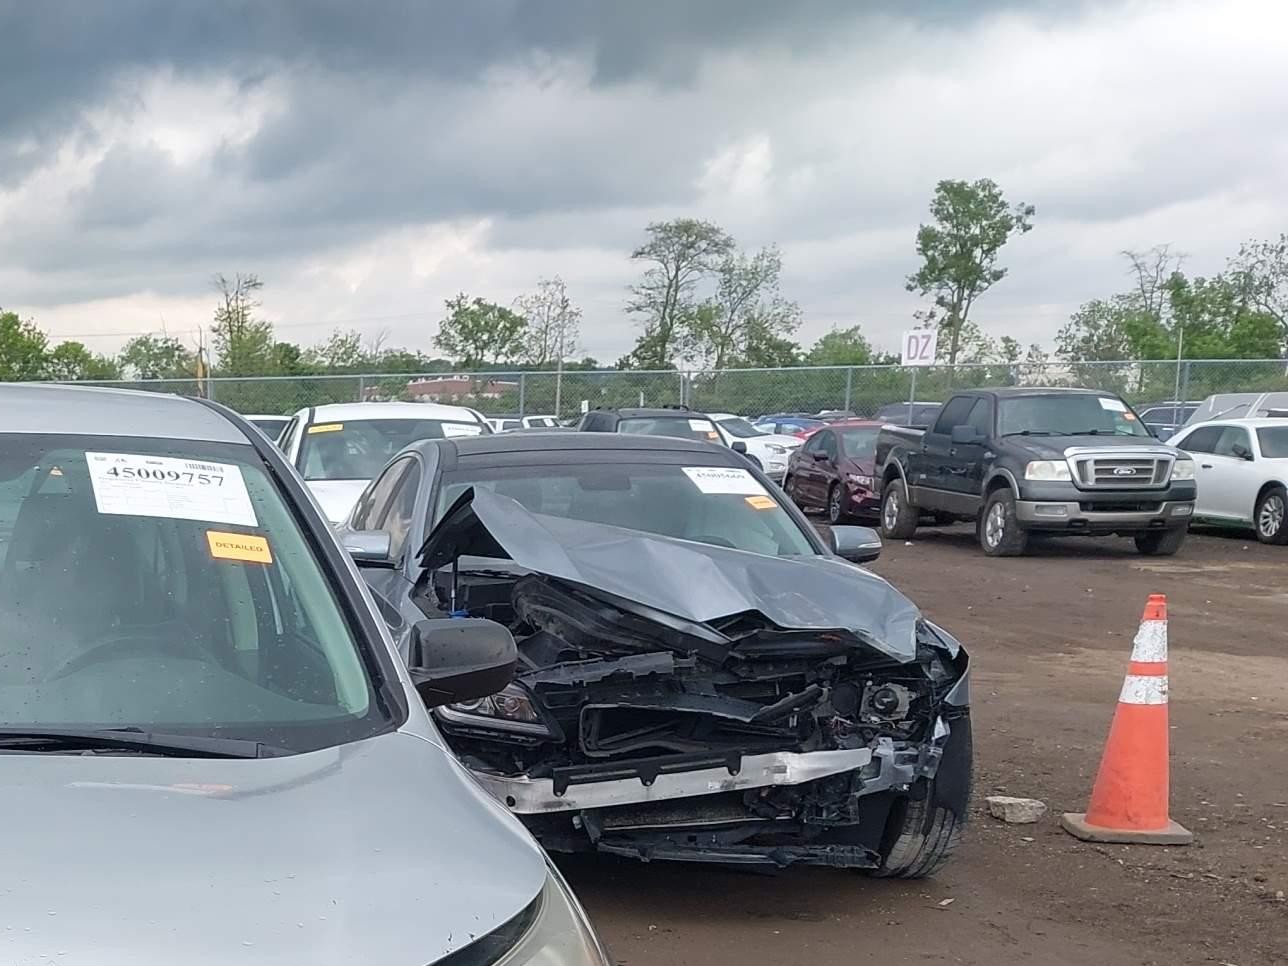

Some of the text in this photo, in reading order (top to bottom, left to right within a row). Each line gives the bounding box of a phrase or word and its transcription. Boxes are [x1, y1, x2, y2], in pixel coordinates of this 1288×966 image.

[907, 334, 932, 361] DZ
[106, 466, 225, 487] 45009757
[215, 541, 264, 552] DETAILED
